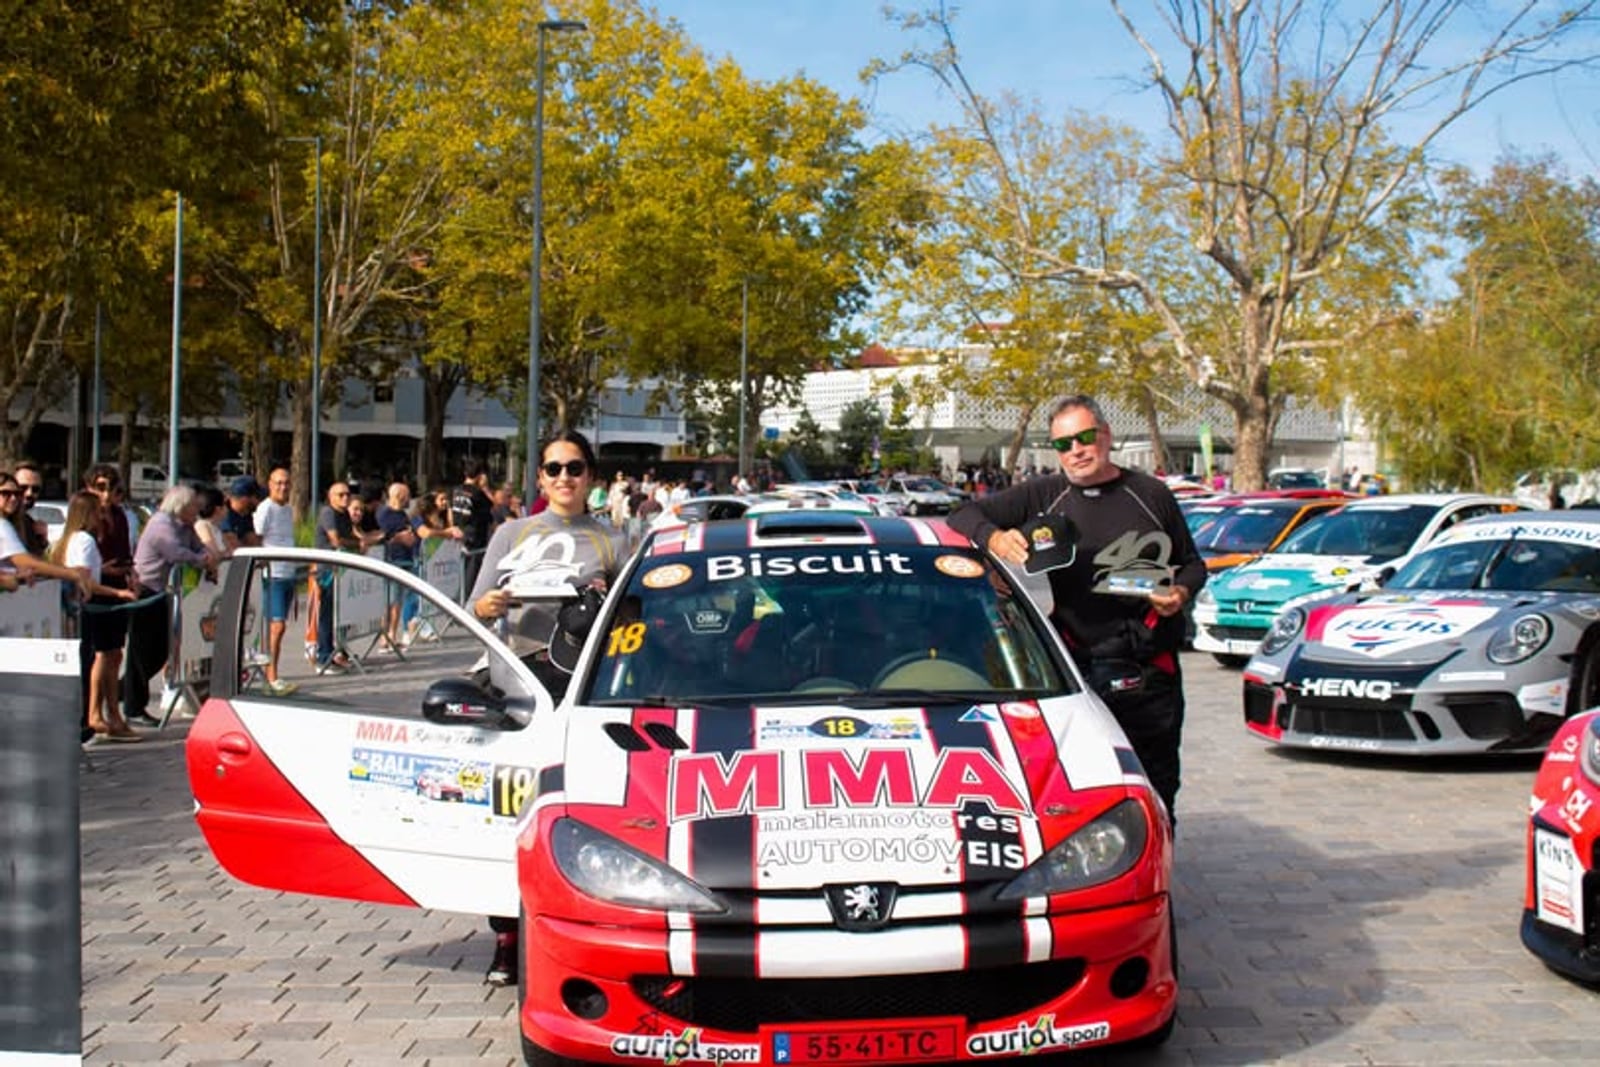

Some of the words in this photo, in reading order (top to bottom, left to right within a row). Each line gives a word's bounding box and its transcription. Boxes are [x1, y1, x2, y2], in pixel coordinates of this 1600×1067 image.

[707, 549, 913, 581] Biscuit
[607, 621, 647, 657] 18
[1335, 618, 1458, 634] FUCHS
[1301, 677, 1393, 701] HENQ
[356, 721, 408, 744] MMA
[823, 719, 856, 736] 18
[497, 766, 534, 816] 18
[670, 747, 1033, 824] MMA
[758, 809, 1019, 833] maiamotores
[758, 833, 1026, 870] AUTOMÓVEIS
[613, 1032, 700, 1060] auriol
[706, 1046, 757, 1066] sport
[968, 1015, 1056, 1055] auriol
[1062, 1024, 1108, 1046] sport
[777, 1050, 787, 1061] P
